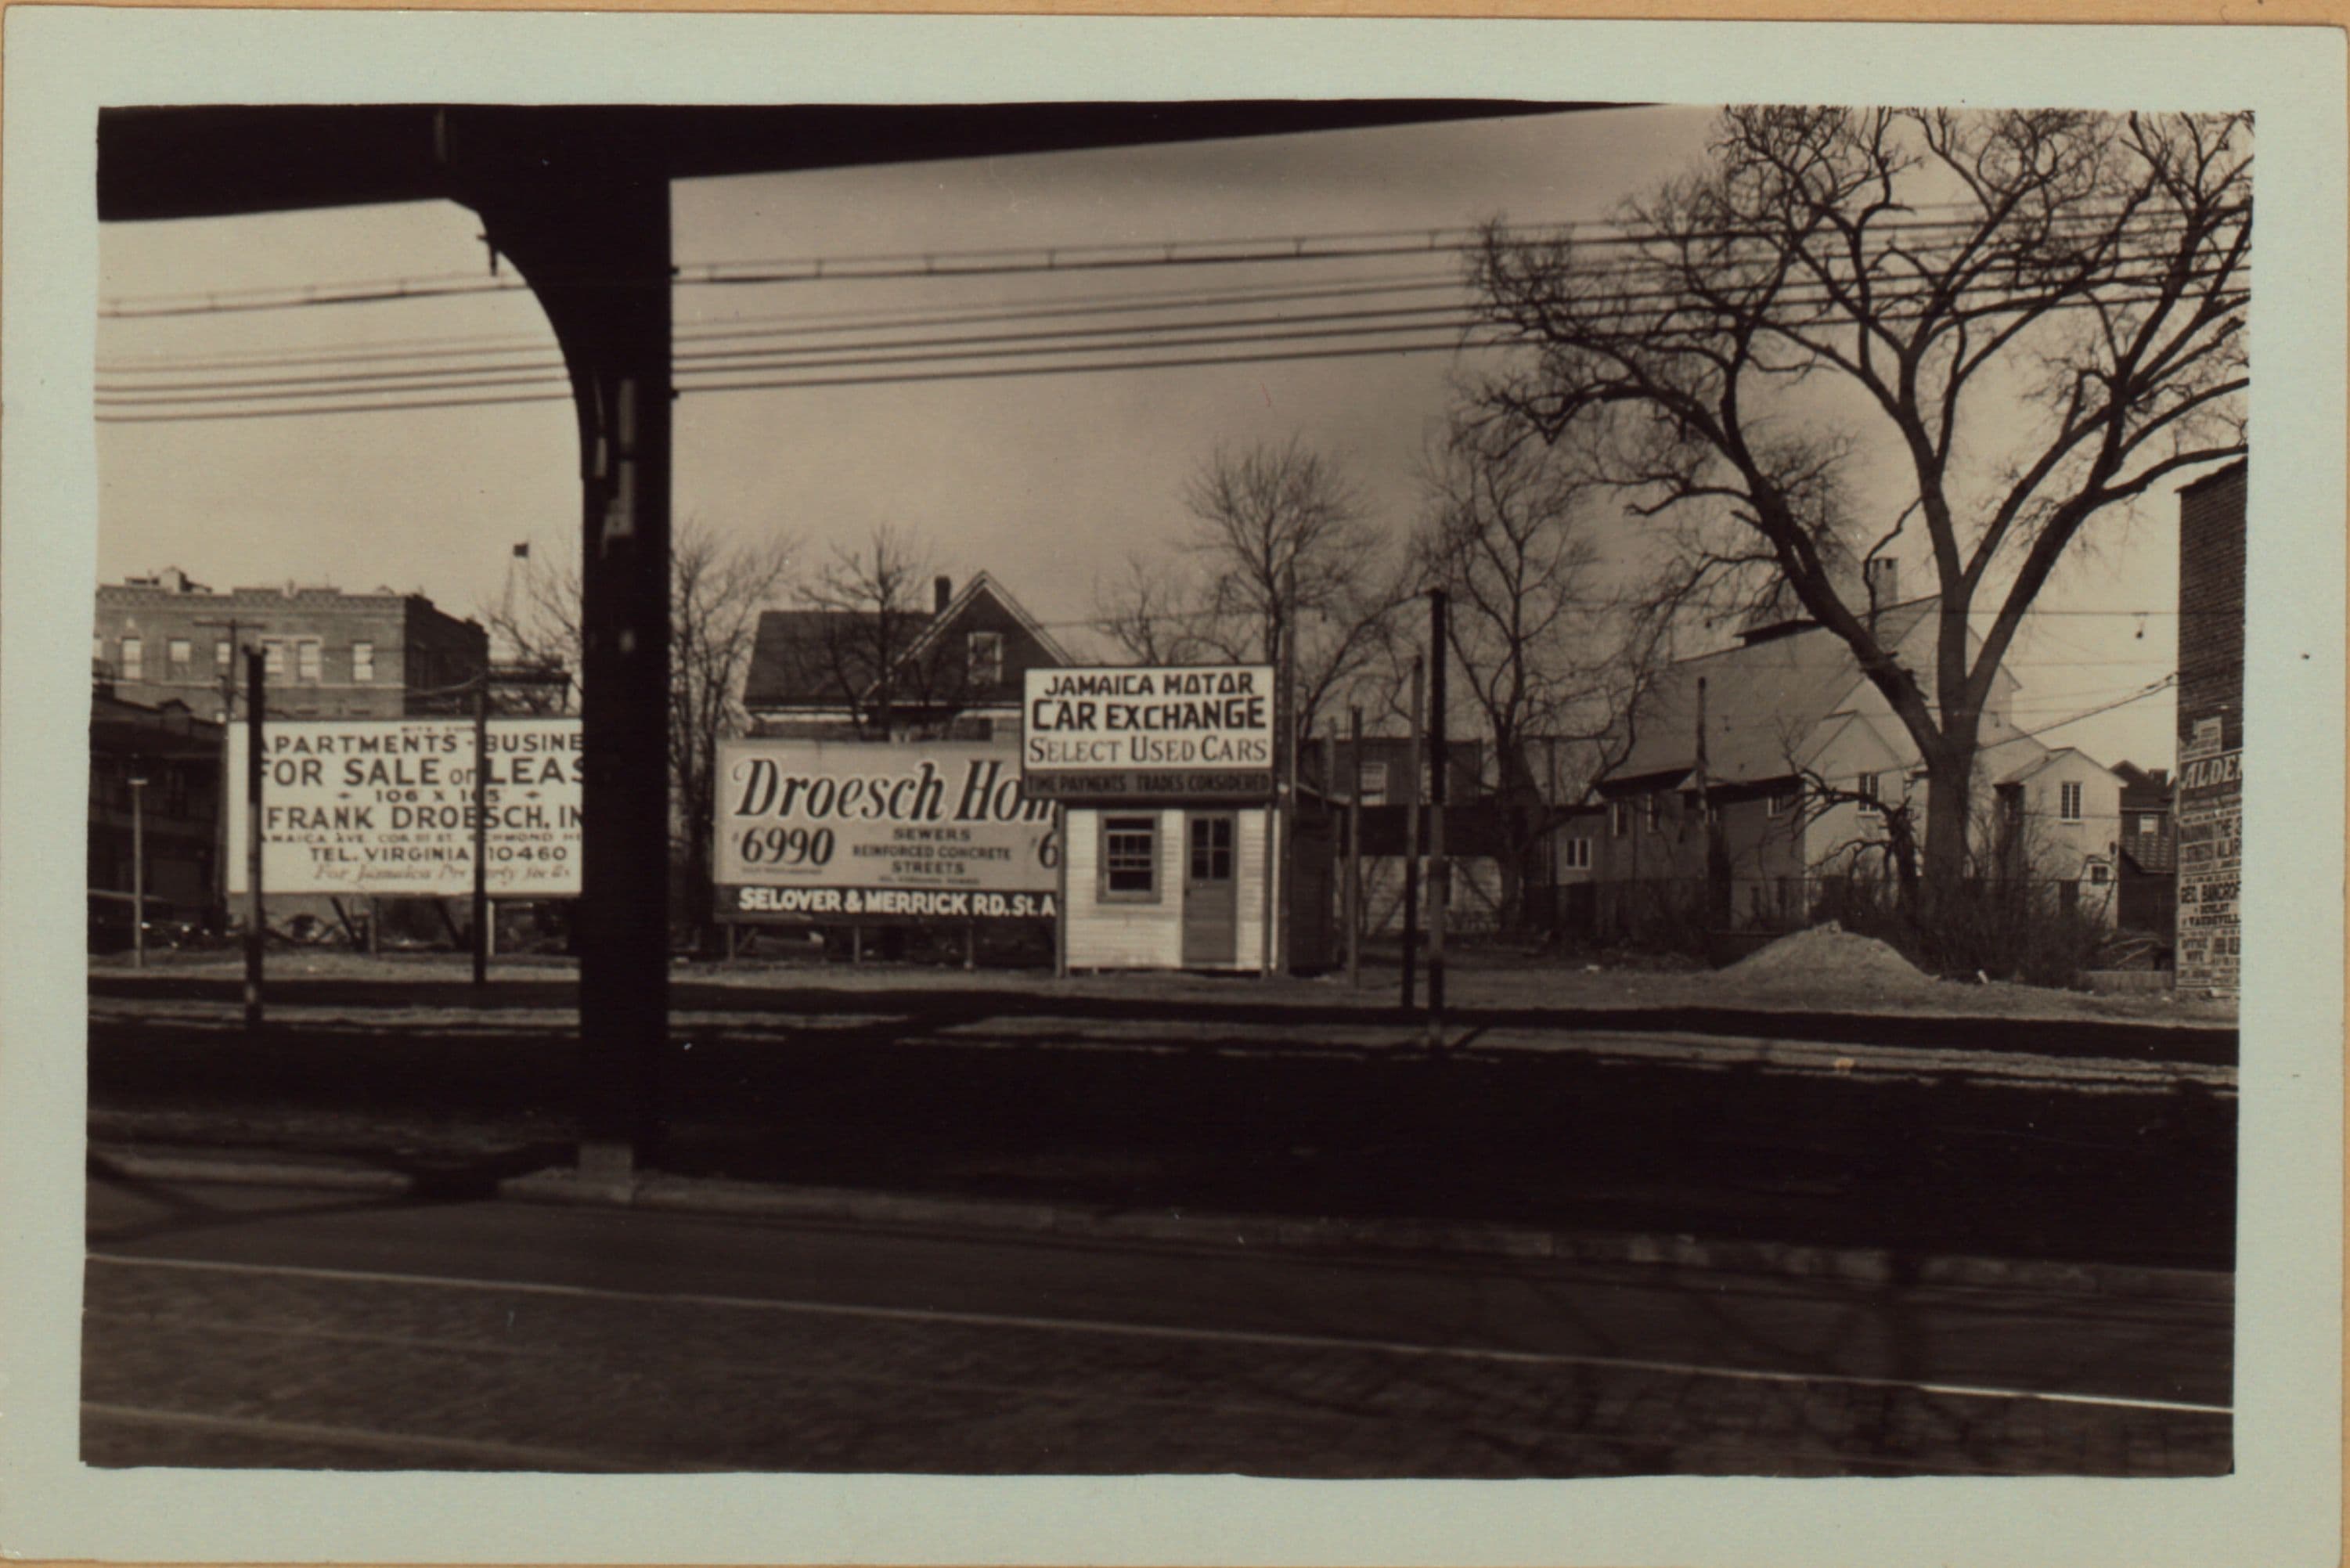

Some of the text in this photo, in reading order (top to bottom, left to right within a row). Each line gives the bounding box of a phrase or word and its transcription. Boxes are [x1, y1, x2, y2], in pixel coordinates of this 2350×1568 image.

[1045, 672, 1253, 696] JAMAICA MOTOR
[1032, 696, 1267, 731] CAR EXCHANGE
[1029, 734, 1268, 763] SELECT USED CARS
[342, 758, 438, 786] SALE
[376, 789, 419, 803] 106
[733, 758, 945, 822] Droesch
[267, 806, 375, 829] FRANK
[892, 827, 971, 842] SEWERS
[308, 846, 359, 863] TEL.
[364, 846, 470, 863] VIRGINIA
[852, 844, 1011, 862] REINFORCED CONCRETE
[892, 860, 965, 875] STREETS
[737, 886, 842, 913] SELOVER
[844, 888, 863, 914] &
[864, 890, 970, 917] MERRICK
